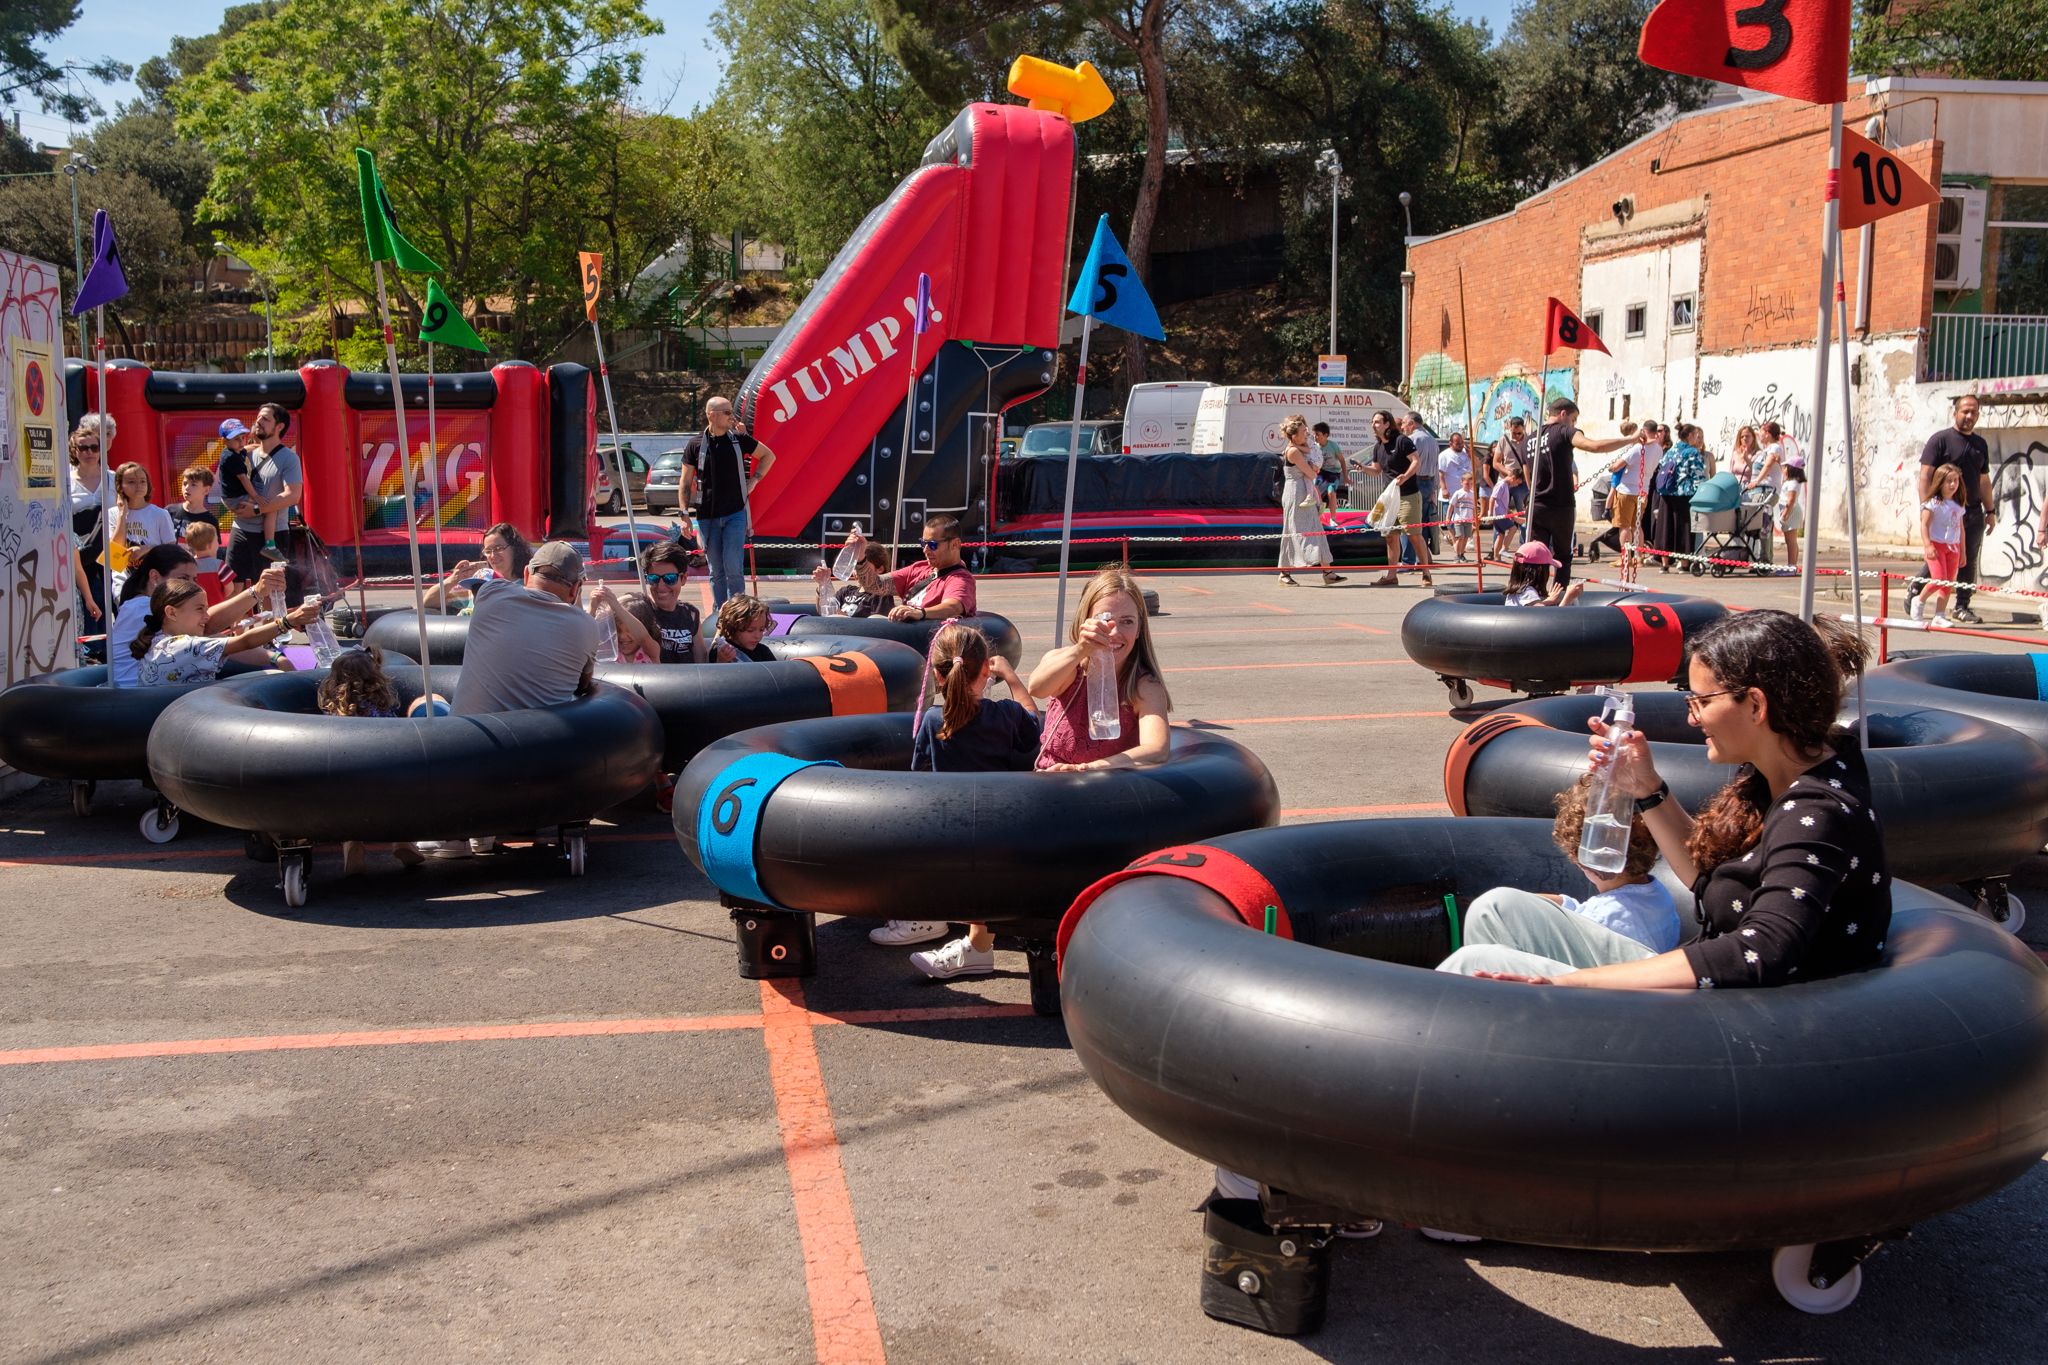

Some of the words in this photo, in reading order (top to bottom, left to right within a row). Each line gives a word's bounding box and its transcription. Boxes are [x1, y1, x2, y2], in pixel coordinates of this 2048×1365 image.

[1723, 0, 1792, 69] 3
[1853, 151, 1901, 207] 10
[586, 262, 599, 301] 5
[420, 302, 448, 333] 9
[1559, 315, 1579, 344] 8
[1239, 392, 1255, 404] LA
[1258, 392, 1287, 405] TEVA
[1290, 393, 1328, 405] FESTA
[1332, 394, 1341, 405] A
[1344, 395, 1373, 407] MIDA
[1526, 432, 1550, 452] STFF
[1637, 605, 1668, 629] 8
[712, 777, 758, 834] 6
